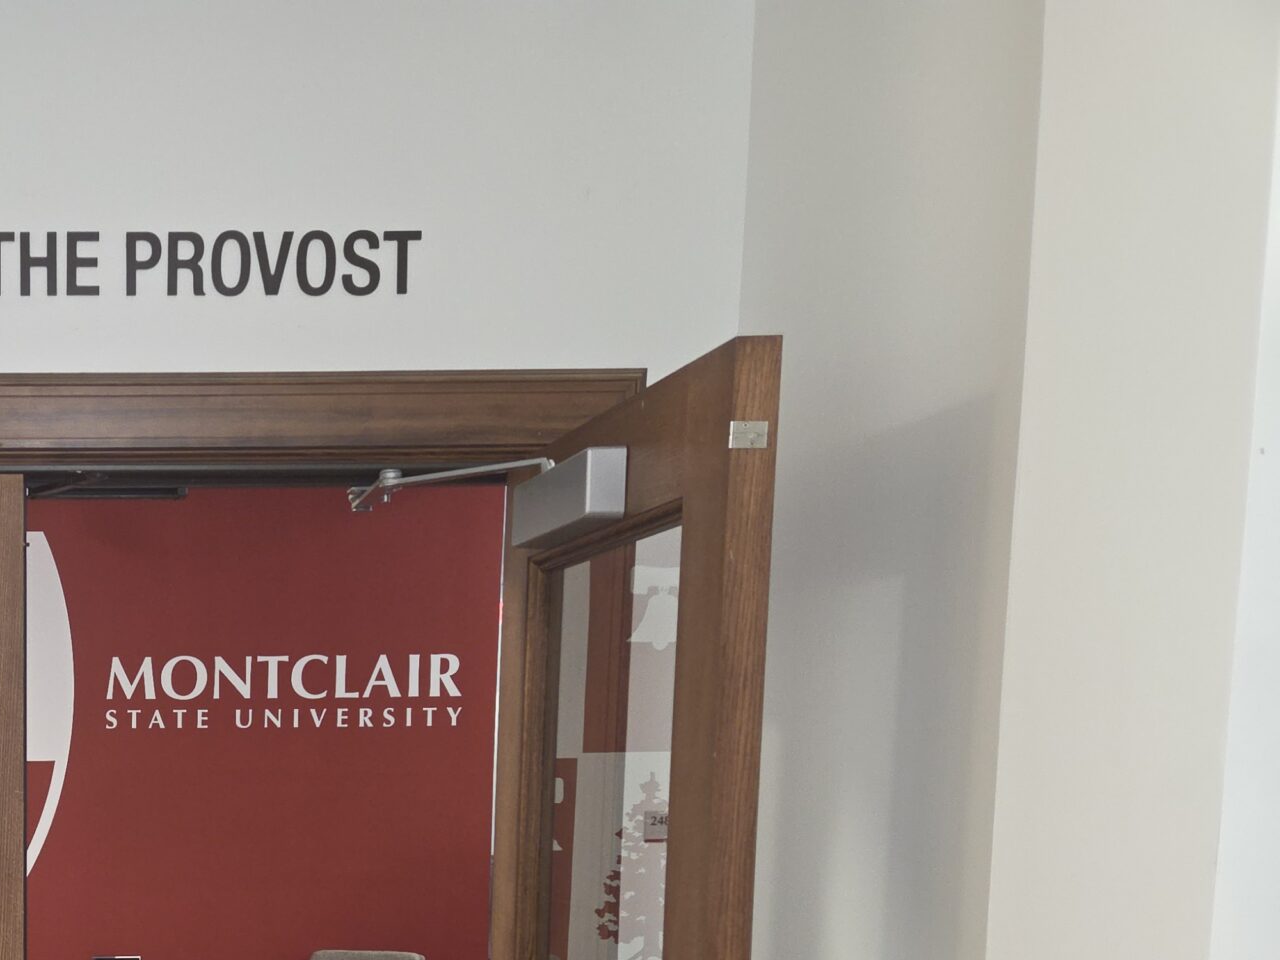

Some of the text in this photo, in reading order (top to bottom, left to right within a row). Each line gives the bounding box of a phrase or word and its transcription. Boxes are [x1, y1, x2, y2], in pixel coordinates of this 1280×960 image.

[125, 229, 423, 297] PROVOST
[105, 653, 462, 701] MONTCLAIR
[105, 706, 463, 730] STATE UNIVERSITY
